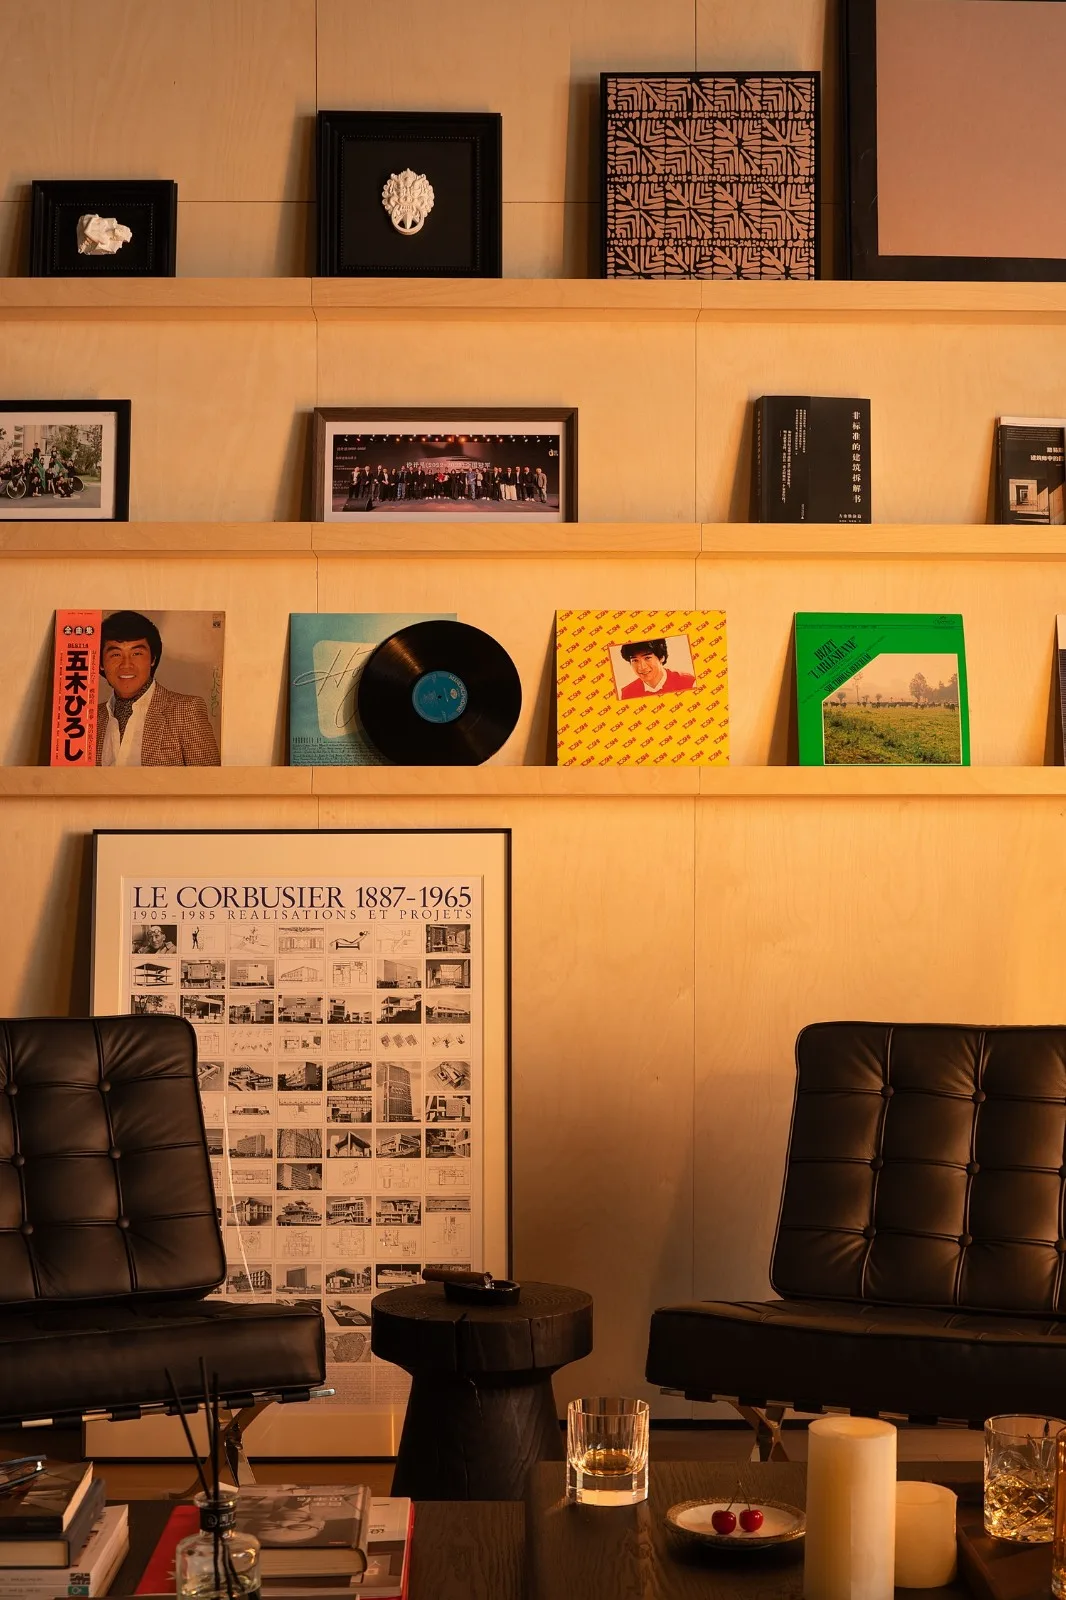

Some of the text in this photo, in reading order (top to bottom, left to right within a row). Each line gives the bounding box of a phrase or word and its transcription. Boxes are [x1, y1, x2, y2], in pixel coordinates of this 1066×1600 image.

[852, 411, 861, 503] 非标准的建筑拆解书
[63, 626, 95, 635] 全曲集
[814, 638, 838, 661] BIZET
[63, 650, 89, 762] 五木ひろし
[133, 886, 472, 909] LE CORBUSIER 1887-1965
[132, 909, 472, 922] 1905-1985 REALISATIONS ET PROJETS
